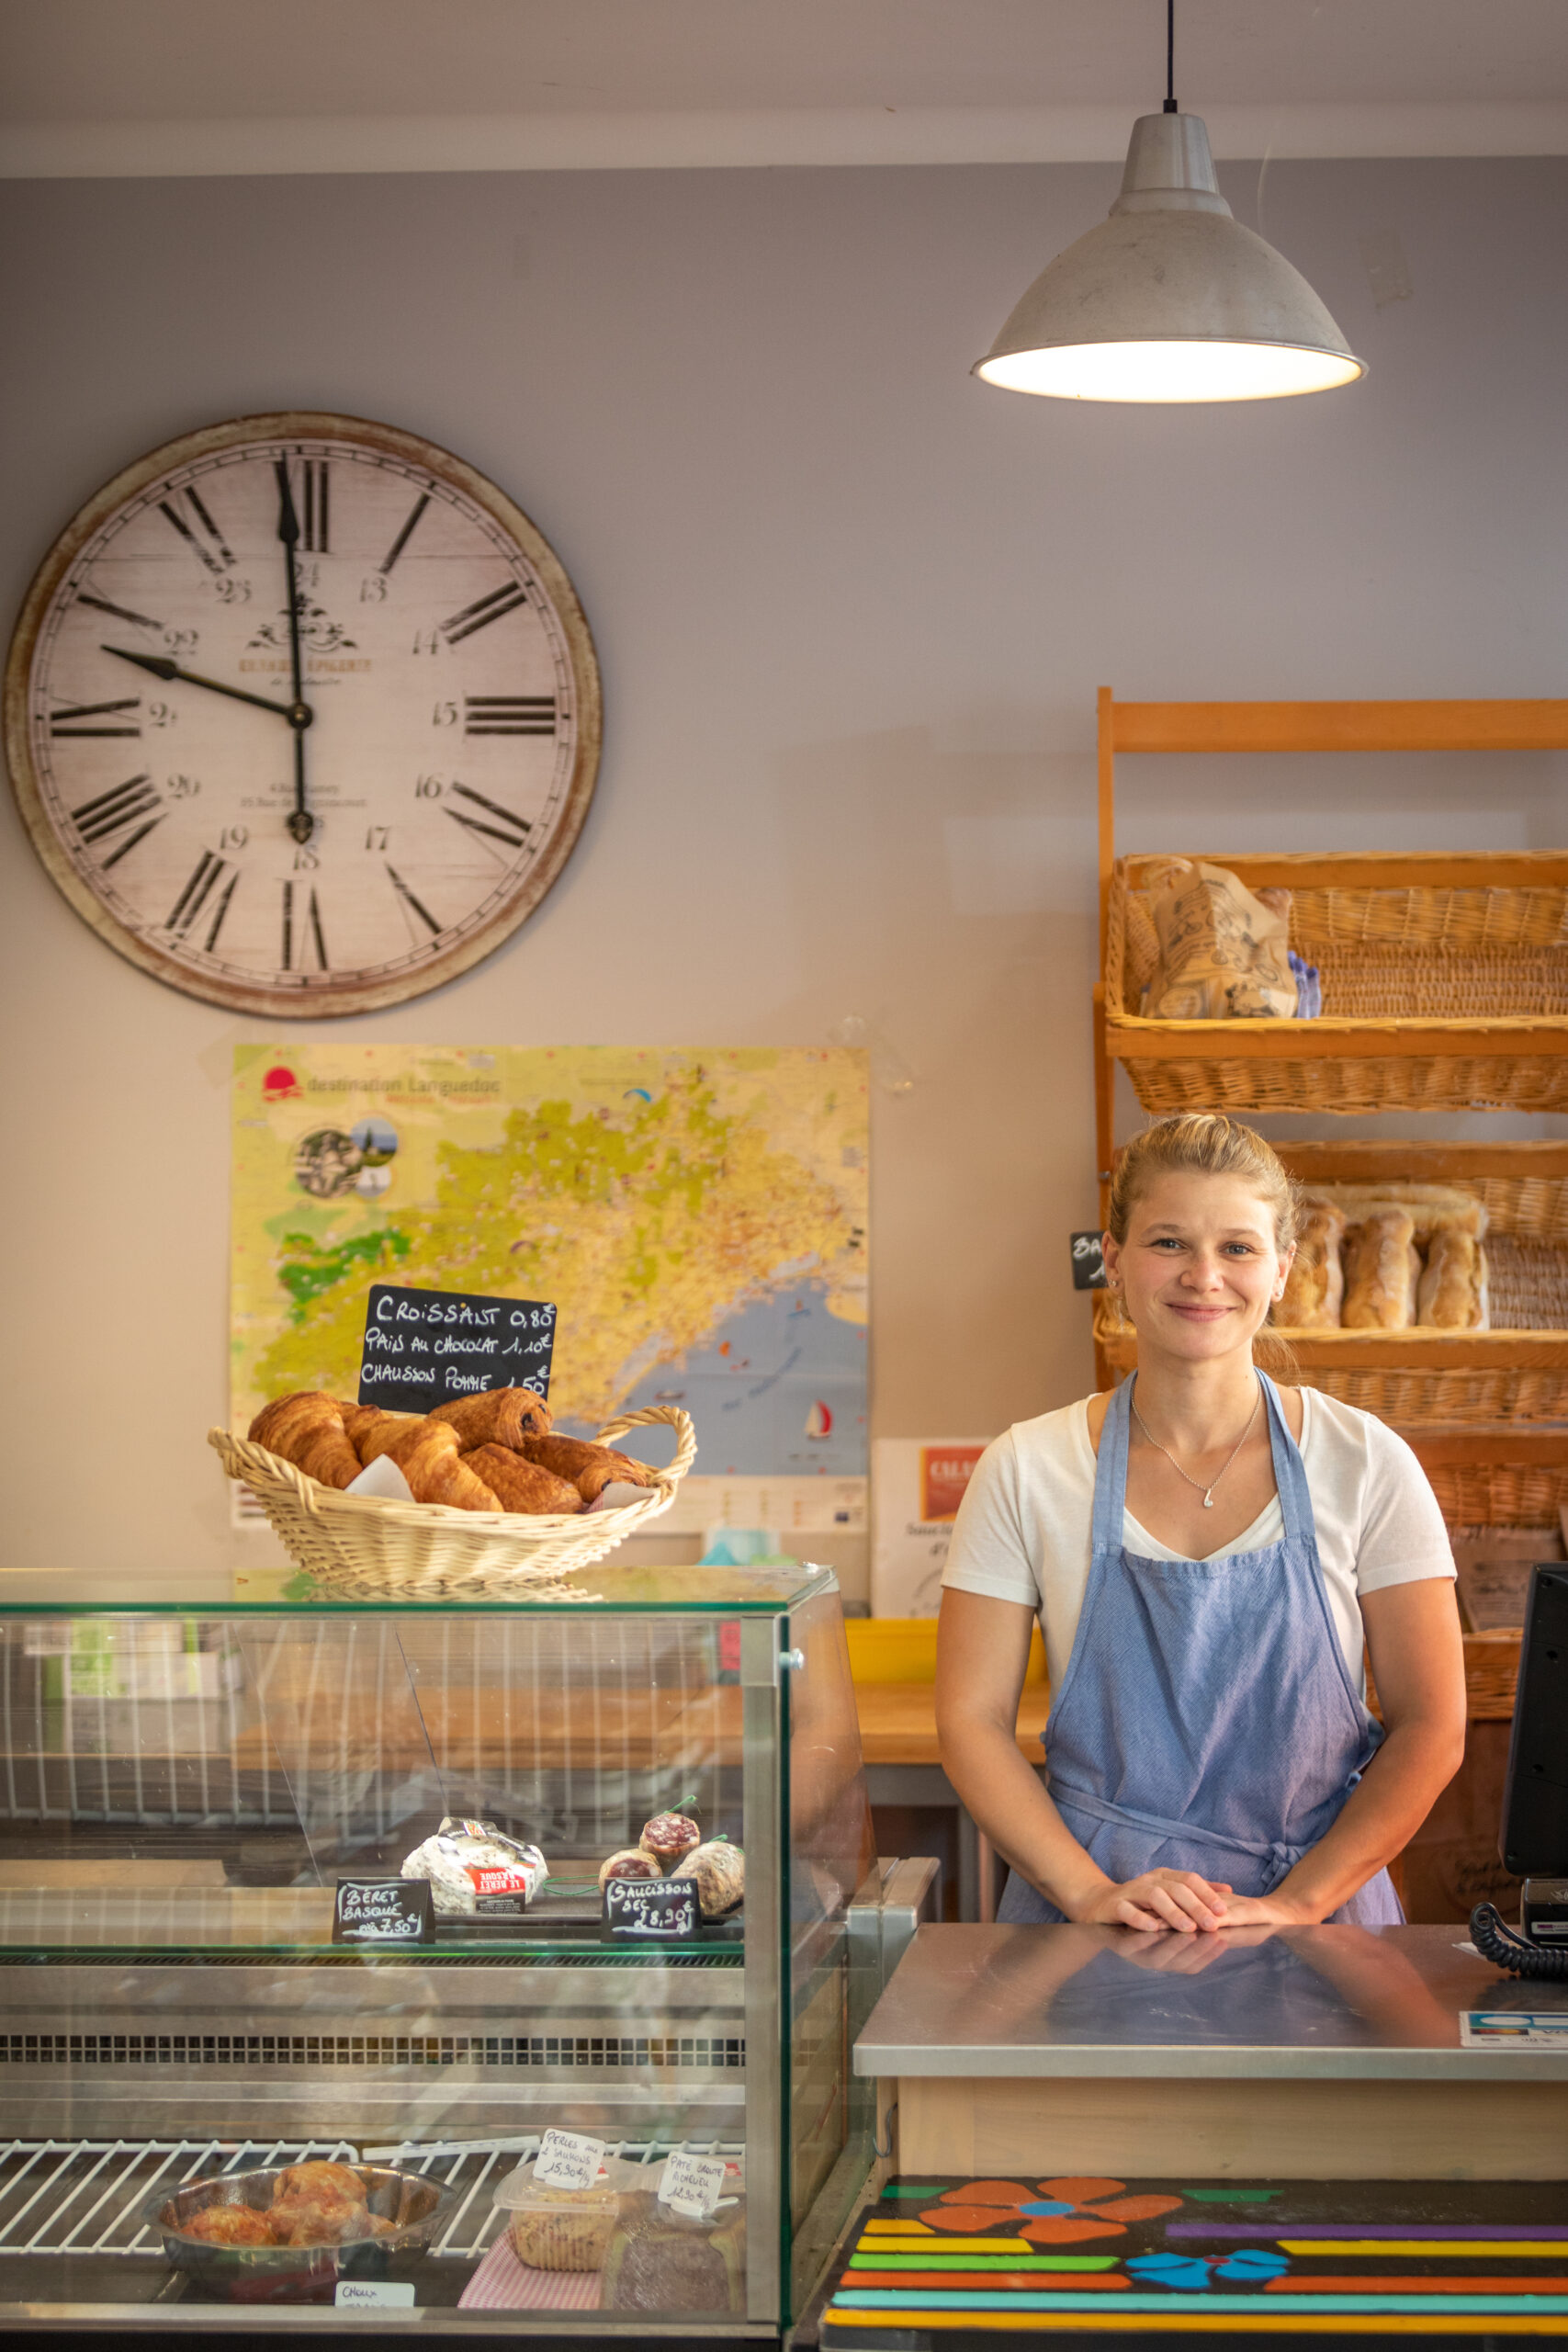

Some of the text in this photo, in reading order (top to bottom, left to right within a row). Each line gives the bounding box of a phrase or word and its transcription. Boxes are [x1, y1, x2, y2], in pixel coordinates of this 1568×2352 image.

[432, 701, 458, 727] 15
[414, 774, 443, 799] 16
[220, 825, 248, 850] 19
[366, 826, 390, 851] 17
[308, 1076, 501, 1096] destination Languedoc
[1073, 1236, 1102, 1260] BA
[434, 1335, 499, 1354] CHOCOLAT
[361, 1363, 435, 1383] CHAUSSON
[446, 1366, 492, 1392] POMME
[622, 1899, 650, 1912] SEC
[547, 2131, 578, 2149] PERLES
